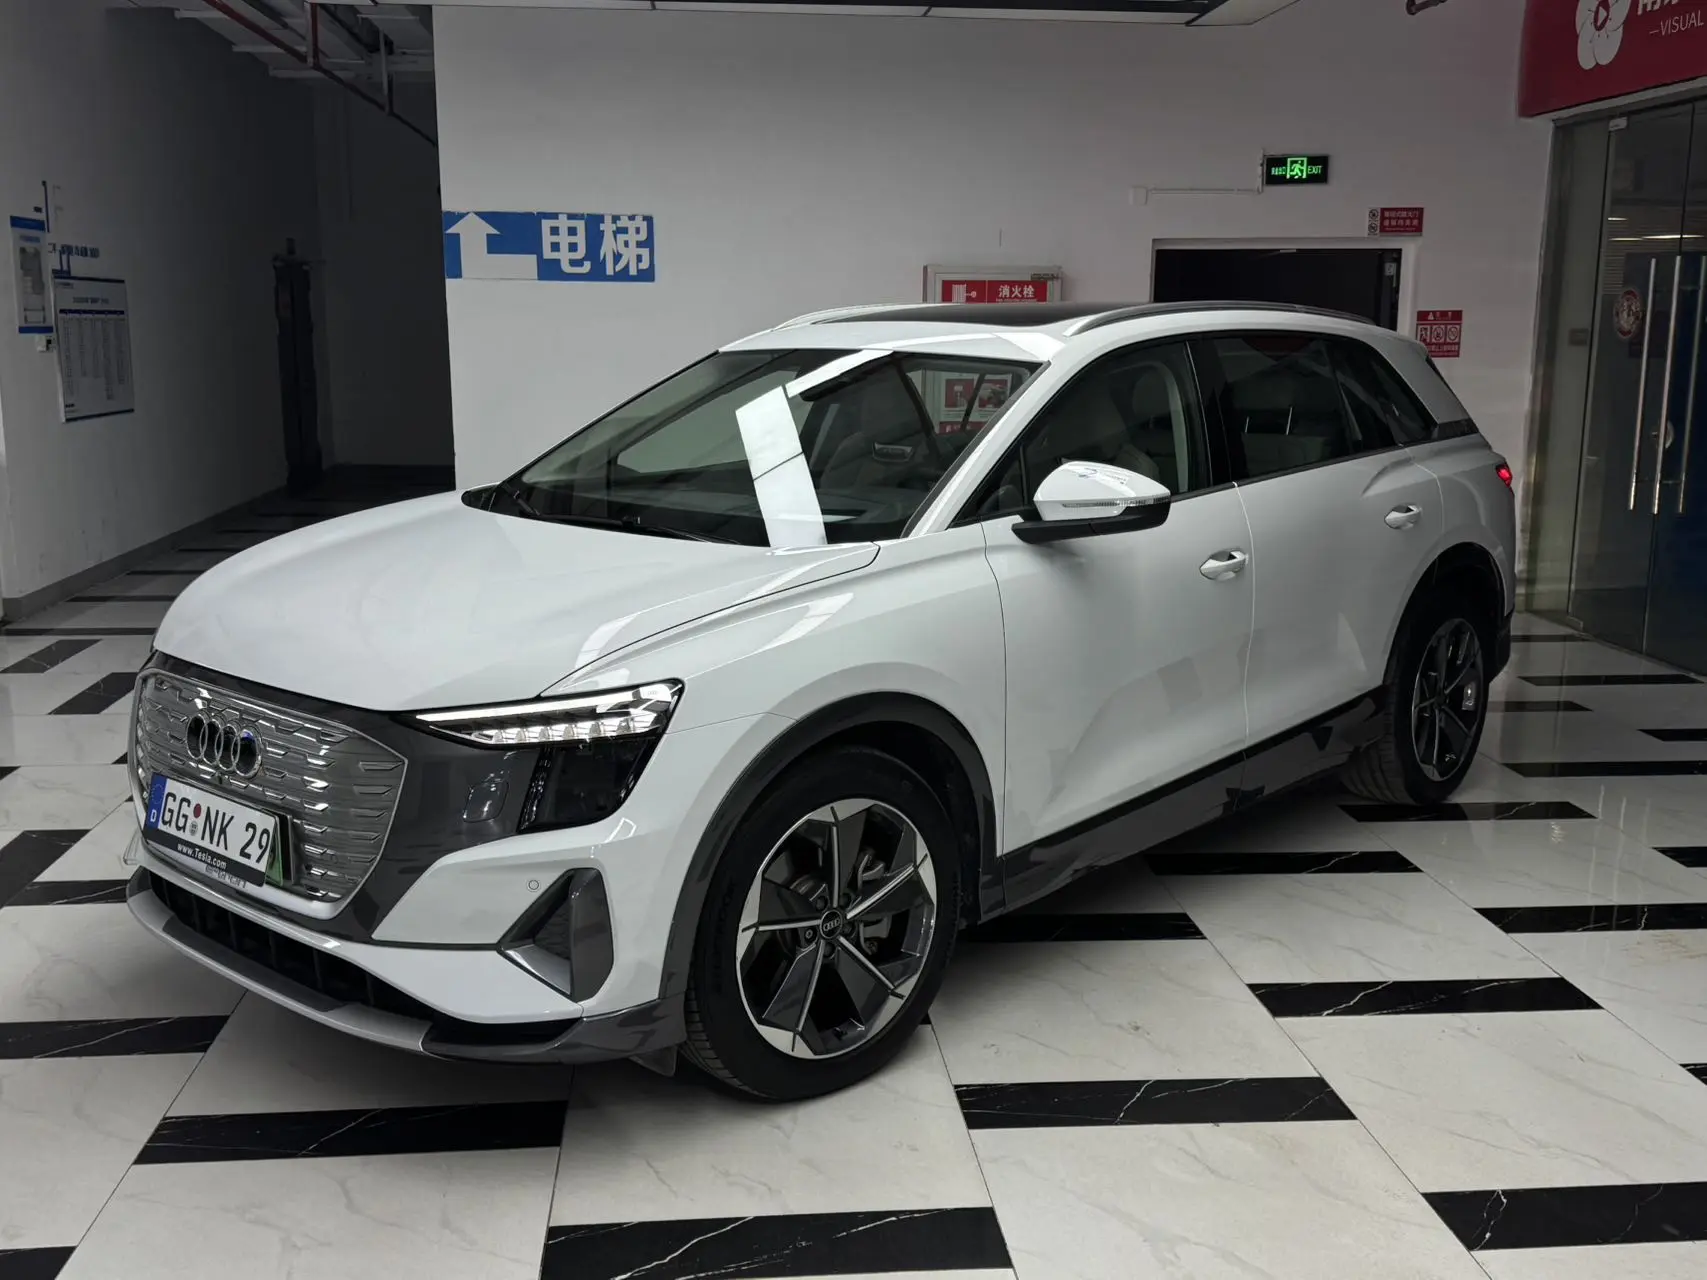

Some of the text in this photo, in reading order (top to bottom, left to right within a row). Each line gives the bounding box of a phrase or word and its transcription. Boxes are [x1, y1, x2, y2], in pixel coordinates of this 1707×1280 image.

[1307, 165, 1323, 175] EXIT
[541, 213, 650, 276] 电梯
[998, 284, 1035, 299] 消火栓
[150, 809, 158, 822] D
[161, 791, 271, 864] GG NK 29
